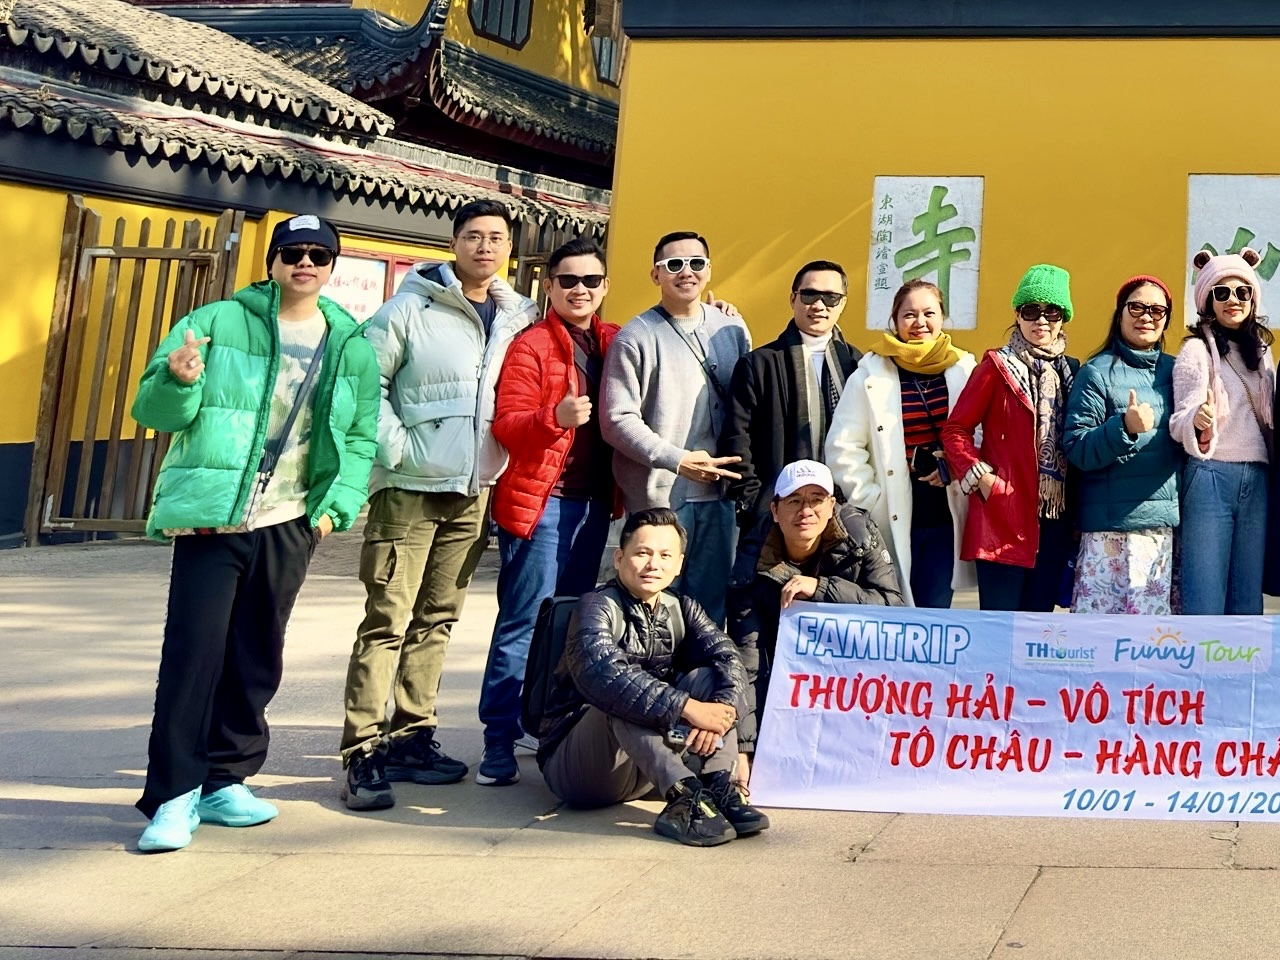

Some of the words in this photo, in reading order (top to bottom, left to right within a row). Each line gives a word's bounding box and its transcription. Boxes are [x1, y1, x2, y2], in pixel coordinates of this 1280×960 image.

[894, 185, 976, 318] 寺
[796, 616, 970, 665] FAMTRIP
[1114, 638, 1196, 669] Funny
[1199, 640, 1261, 662] Tour
[789, 672, 933, 720] THƯỢNG
[946, 673, 1015, 721] HẢI
[1059, 681, 1110, 724] VÔ
[1122, 683, 1206, 726] TÍCH
[889, 726, 935, 768] TÔ
[946, 729, 1052, 773] CHÂU
[1096, 733, 1202, 779] HÀNG
[1062, 788, 1136, 812] 10/01
